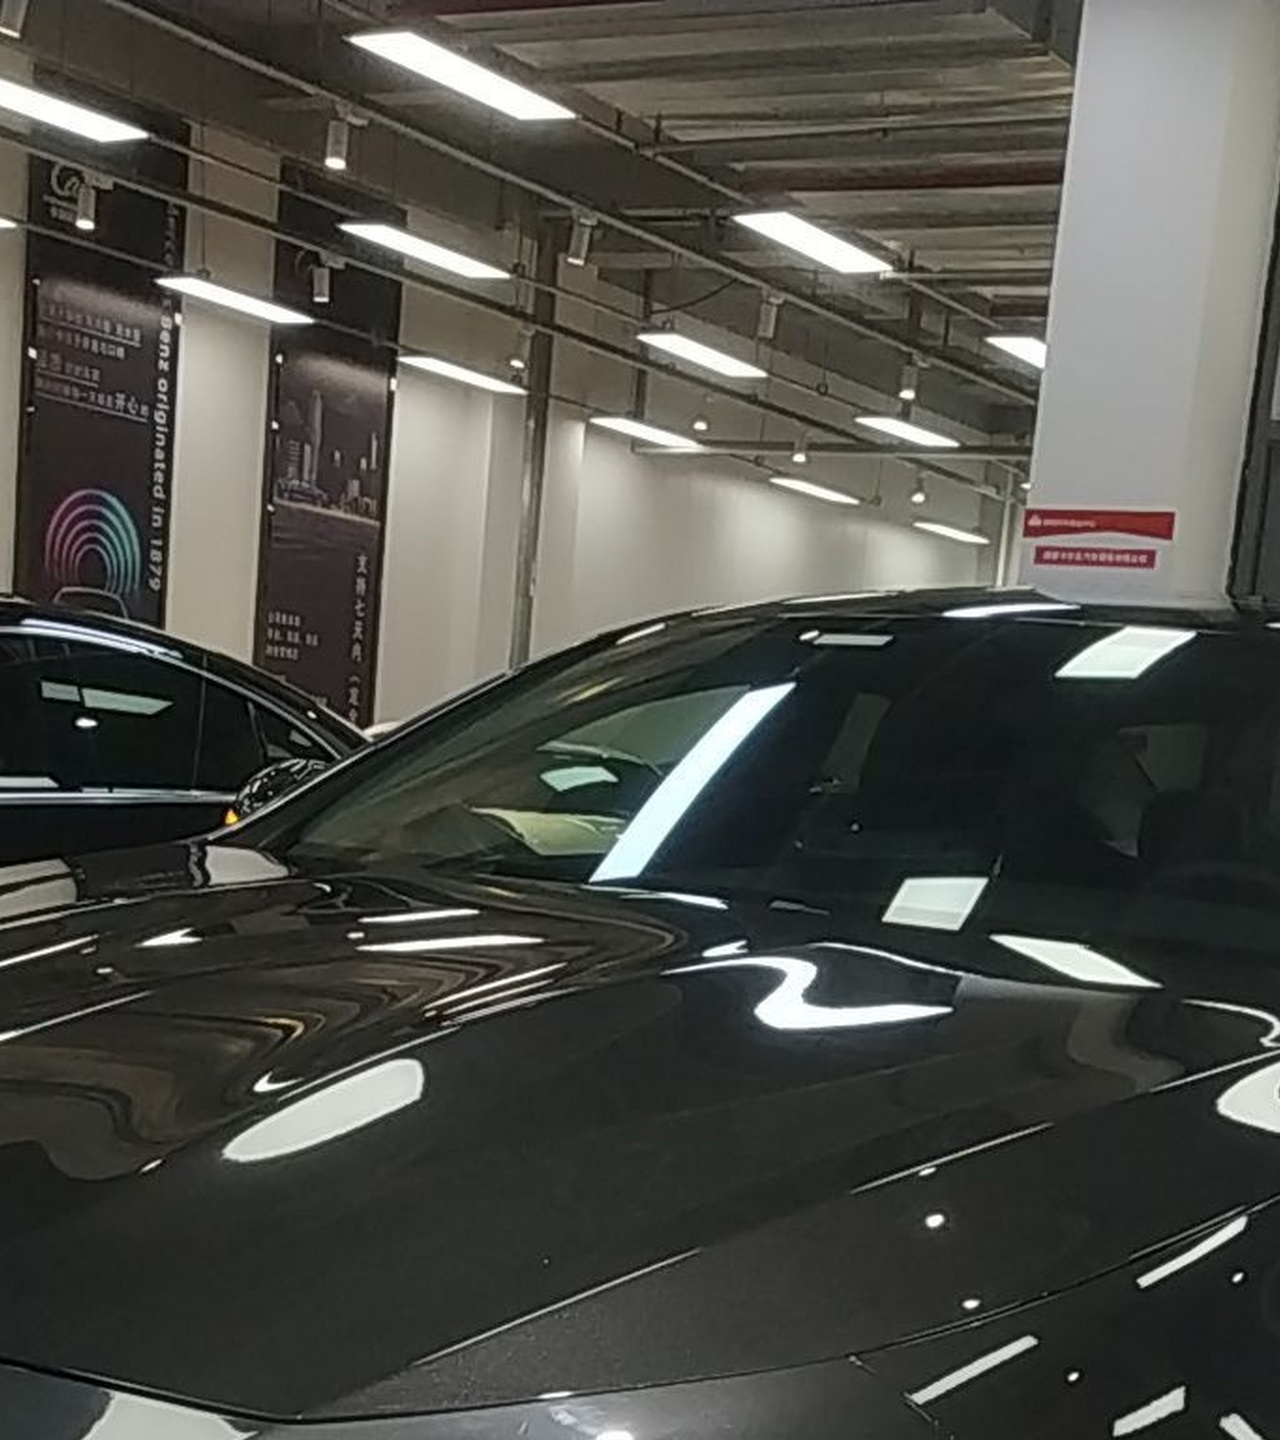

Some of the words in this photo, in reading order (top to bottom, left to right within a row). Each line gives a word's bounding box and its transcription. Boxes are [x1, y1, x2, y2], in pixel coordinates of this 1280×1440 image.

[151, 377, 170, 500] originated
[151, 505, 166, 528] in
[147, 537, 164, 592] 1879
